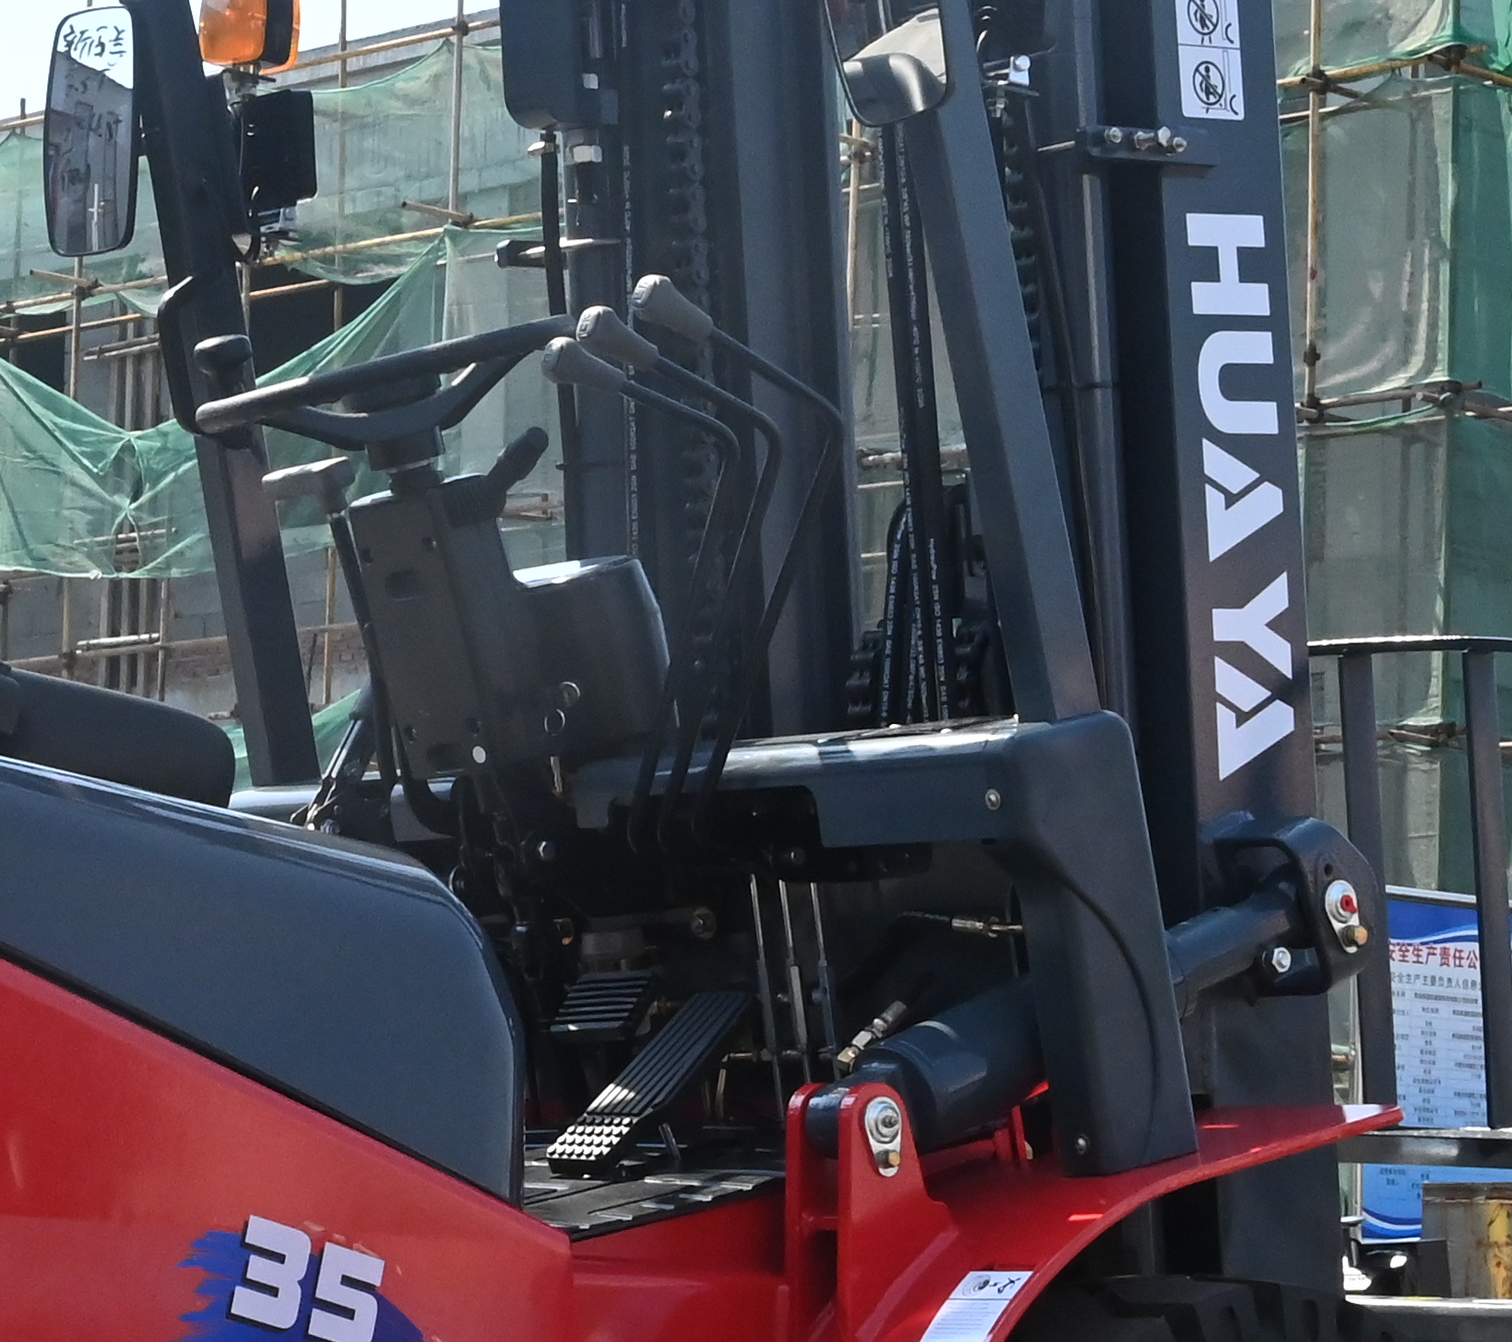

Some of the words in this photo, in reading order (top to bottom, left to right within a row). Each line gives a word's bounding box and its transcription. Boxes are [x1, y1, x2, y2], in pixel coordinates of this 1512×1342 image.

[1185, 212, 1295, 781] HUAYA
[1390, 971, 1481, 992] 安全生产主要负责人信息
